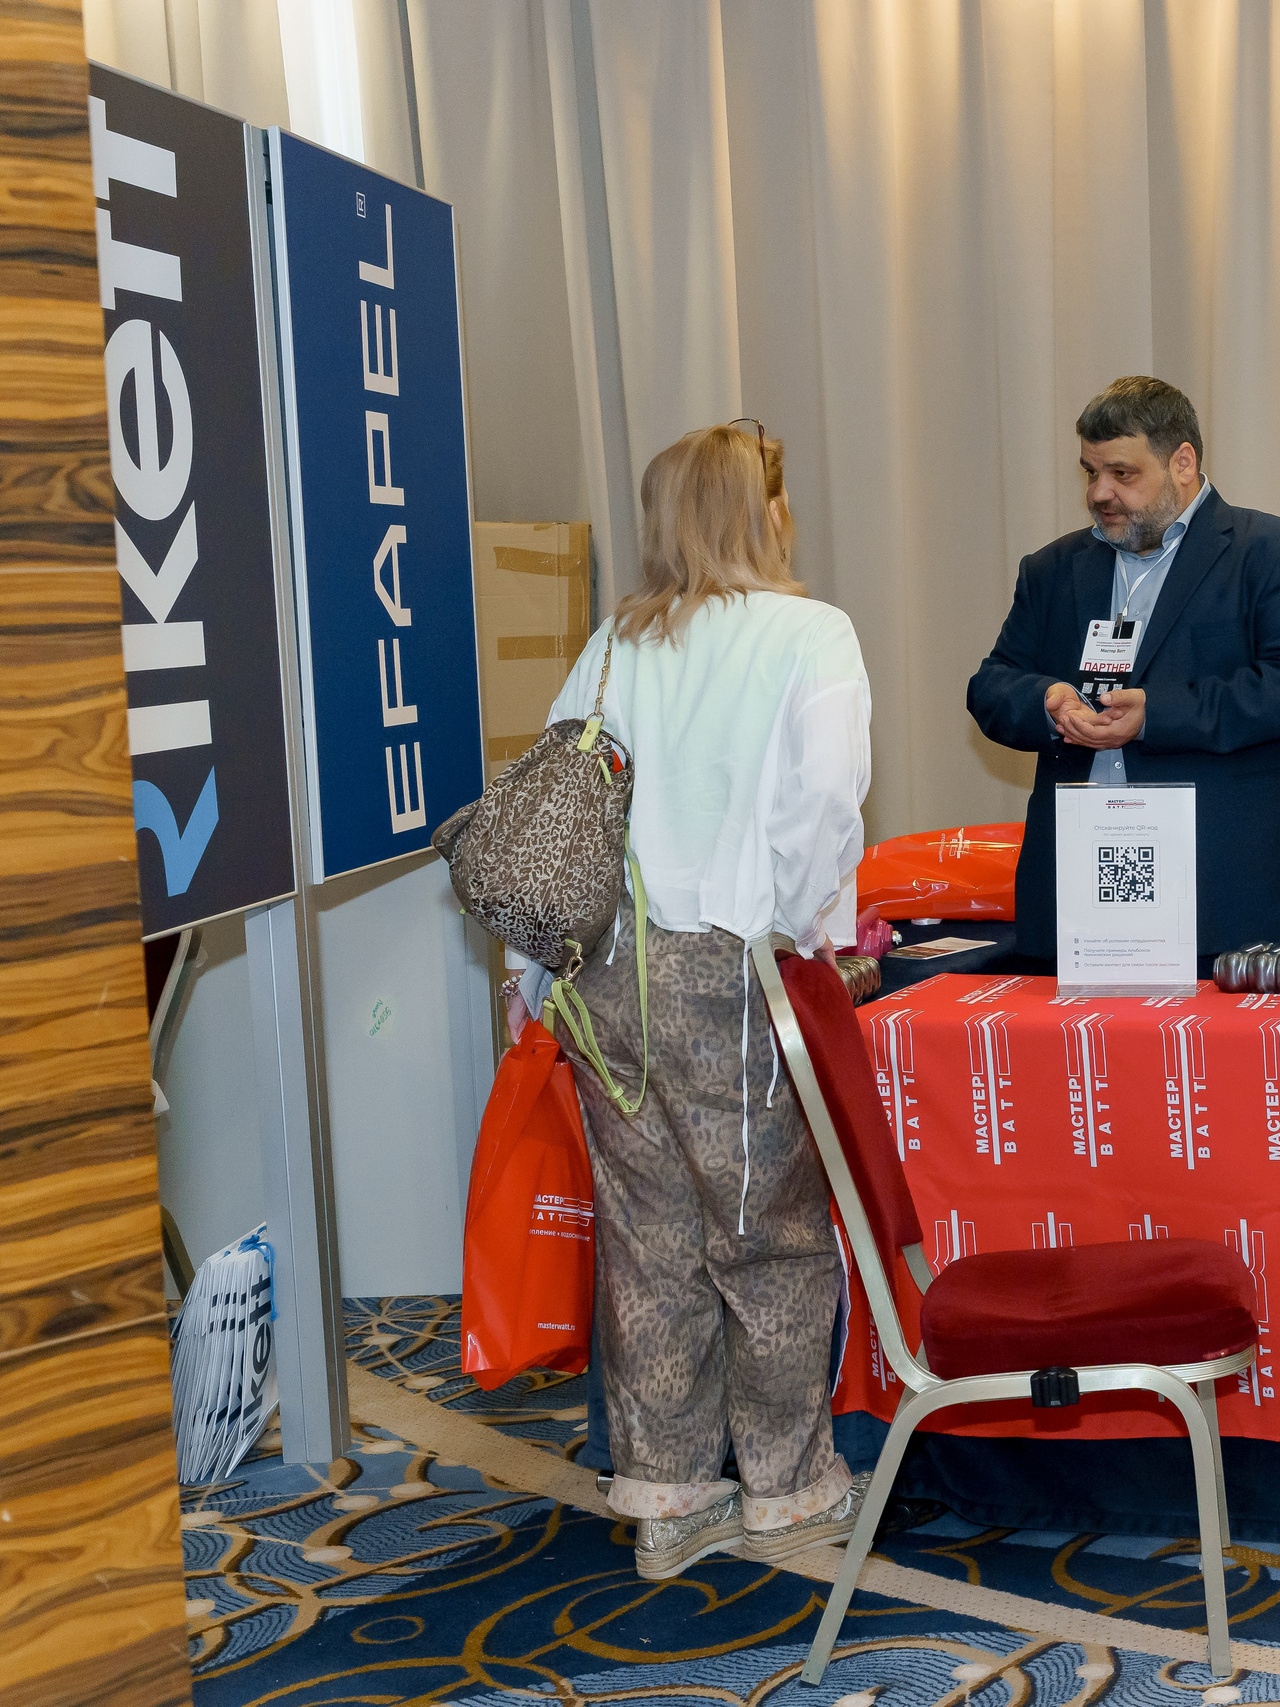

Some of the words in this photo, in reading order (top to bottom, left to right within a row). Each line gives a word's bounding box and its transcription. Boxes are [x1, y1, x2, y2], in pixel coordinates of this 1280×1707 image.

[358, 203, 427, 835] EFAPEL
[1084, 662, 1131, 672] ПАРТНЕР
[903, 1074, 921, 1150] ВАТТ
[972, 1075, 990, 1154] МАСТЕР
[999, 1077, 1017, 1153] ВАТТ
[1069, 1077, 1087, 1155] МАСТЕР
[1095, 1079, 1113, 1156] ВАТТ
[1166, 1079, 1184, 1158] МАСТЕР
[1194, 1082, 1211, 1159] ВАТТ
[532, 1211, 562, 1221] АТТ
[868, 1314, 880, 1378] МАСТЕ
[1259, 1324, 1275, 1398] ВАТТ
